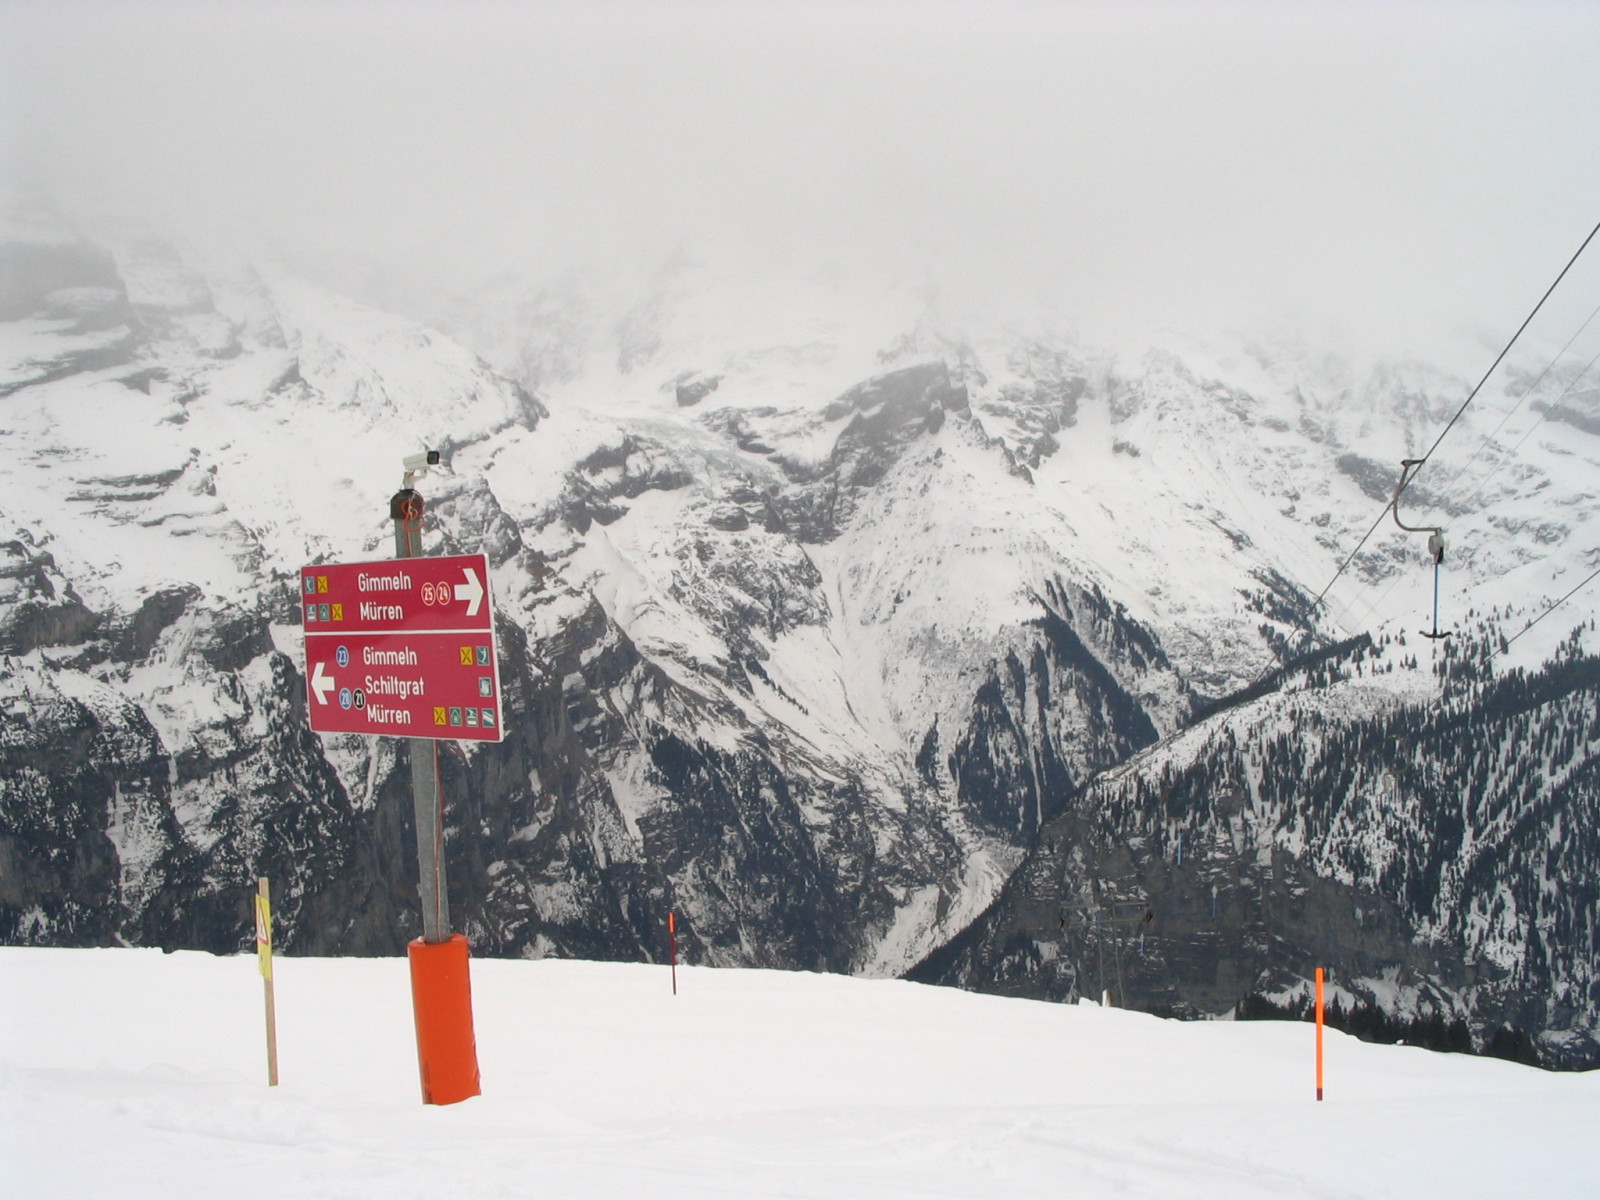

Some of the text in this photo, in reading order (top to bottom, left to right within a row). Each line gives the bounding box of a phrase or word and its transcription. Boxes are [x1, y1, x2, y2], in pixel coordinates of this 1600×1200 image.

[358, 571, 412, 592] Gimmeln
[423, 586, 449, 601] 25 24
[360, 602, 403, 621] Mürren
[338, 646, 418, 666] 23 Gimmeln
[365, 675, 424, 699] Schiltgrat
[341, 692, 364, 705] 20 21
[366, 704, 411, 724] Mürren
